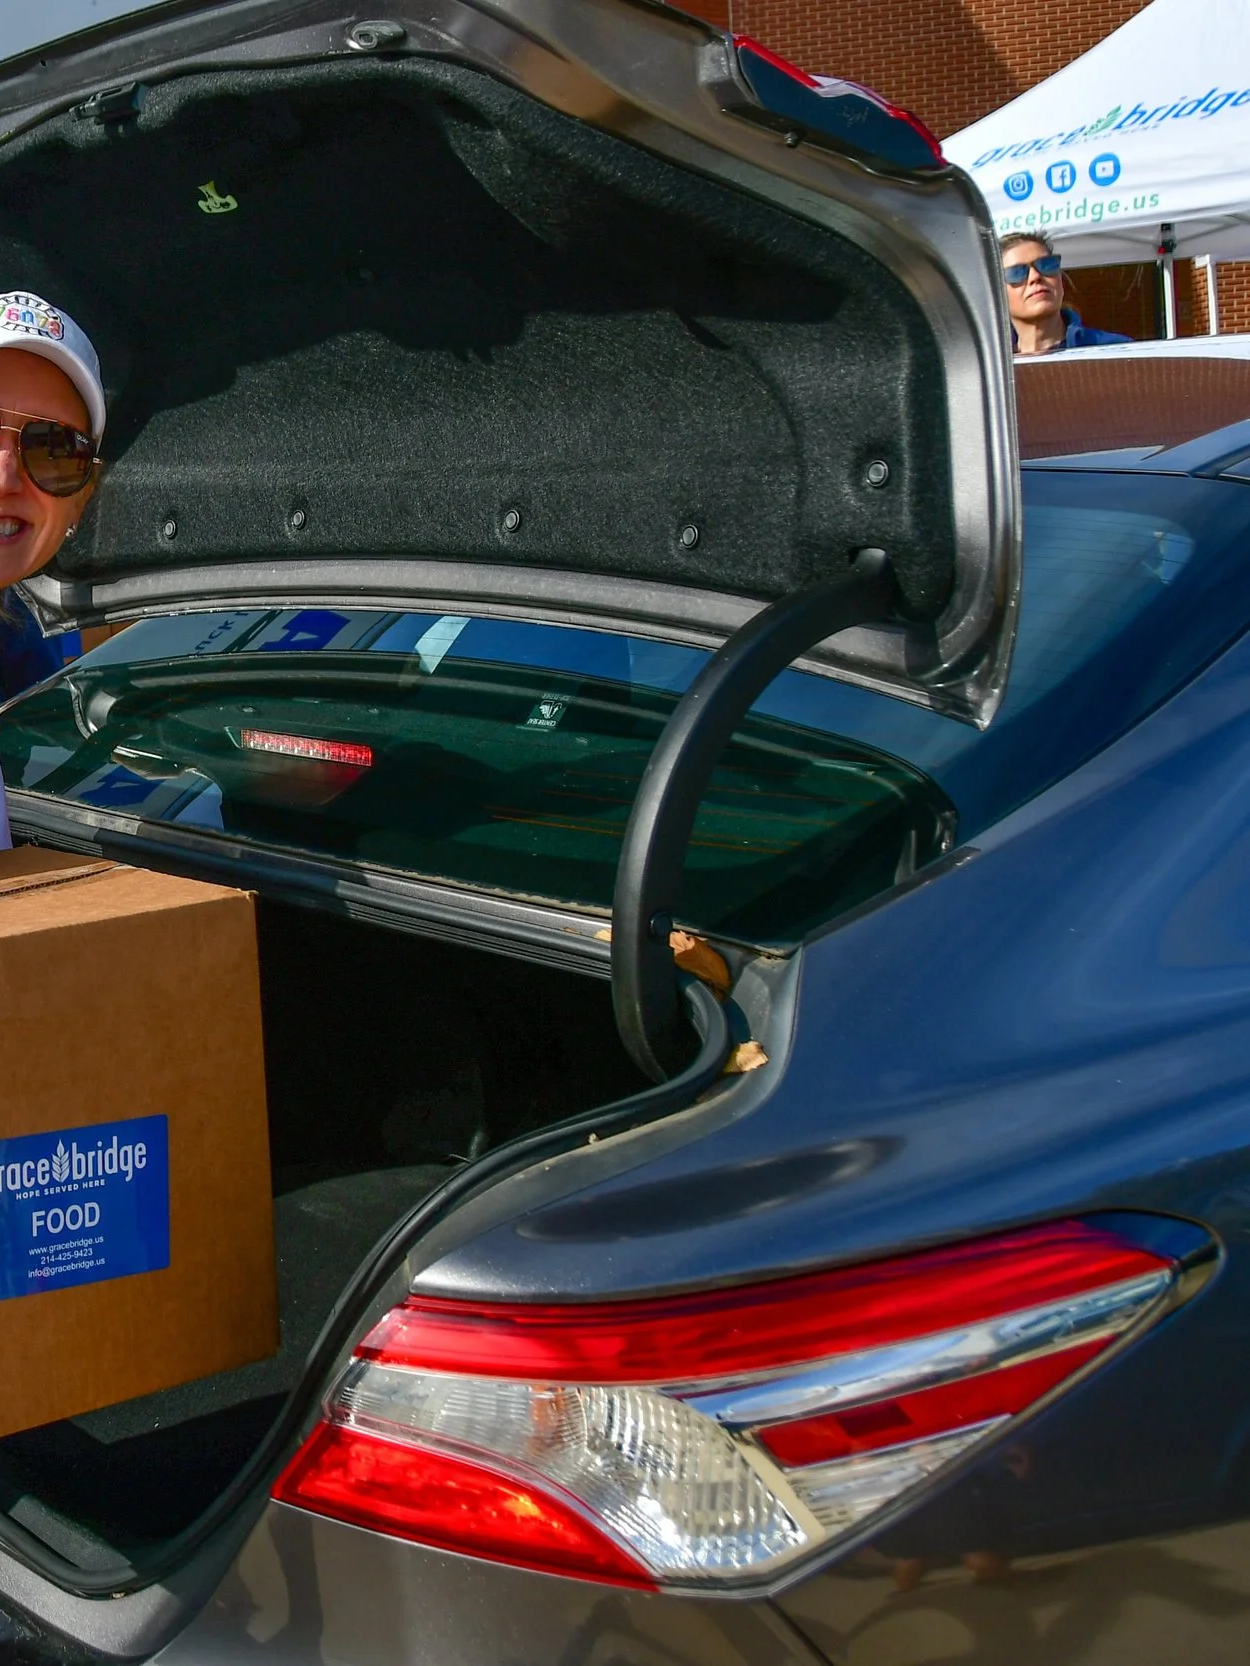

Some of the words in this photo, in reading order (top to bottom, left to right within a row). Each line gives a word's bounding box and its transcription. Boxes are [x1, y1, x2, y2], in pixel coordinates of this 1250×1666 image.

[970, 125, 1086, 170] grace
[992, 192, 1160, 231] acebridge.us
[71, 1135, 147, 1182] bridge
[15, 1189, 41, 1200] HOPE
[44, 1183, 79, 1196] SERVED
[82, 1179, 106, 1189] HERE
[32, 1201, 101, 1237] FOOD
[28, 1235, 104, 1256] www.gracebridge.us
[40, 1248, 93, 1265] 214-425-9423
[27, 1257, 106, 1278] info@gracebridge.us
